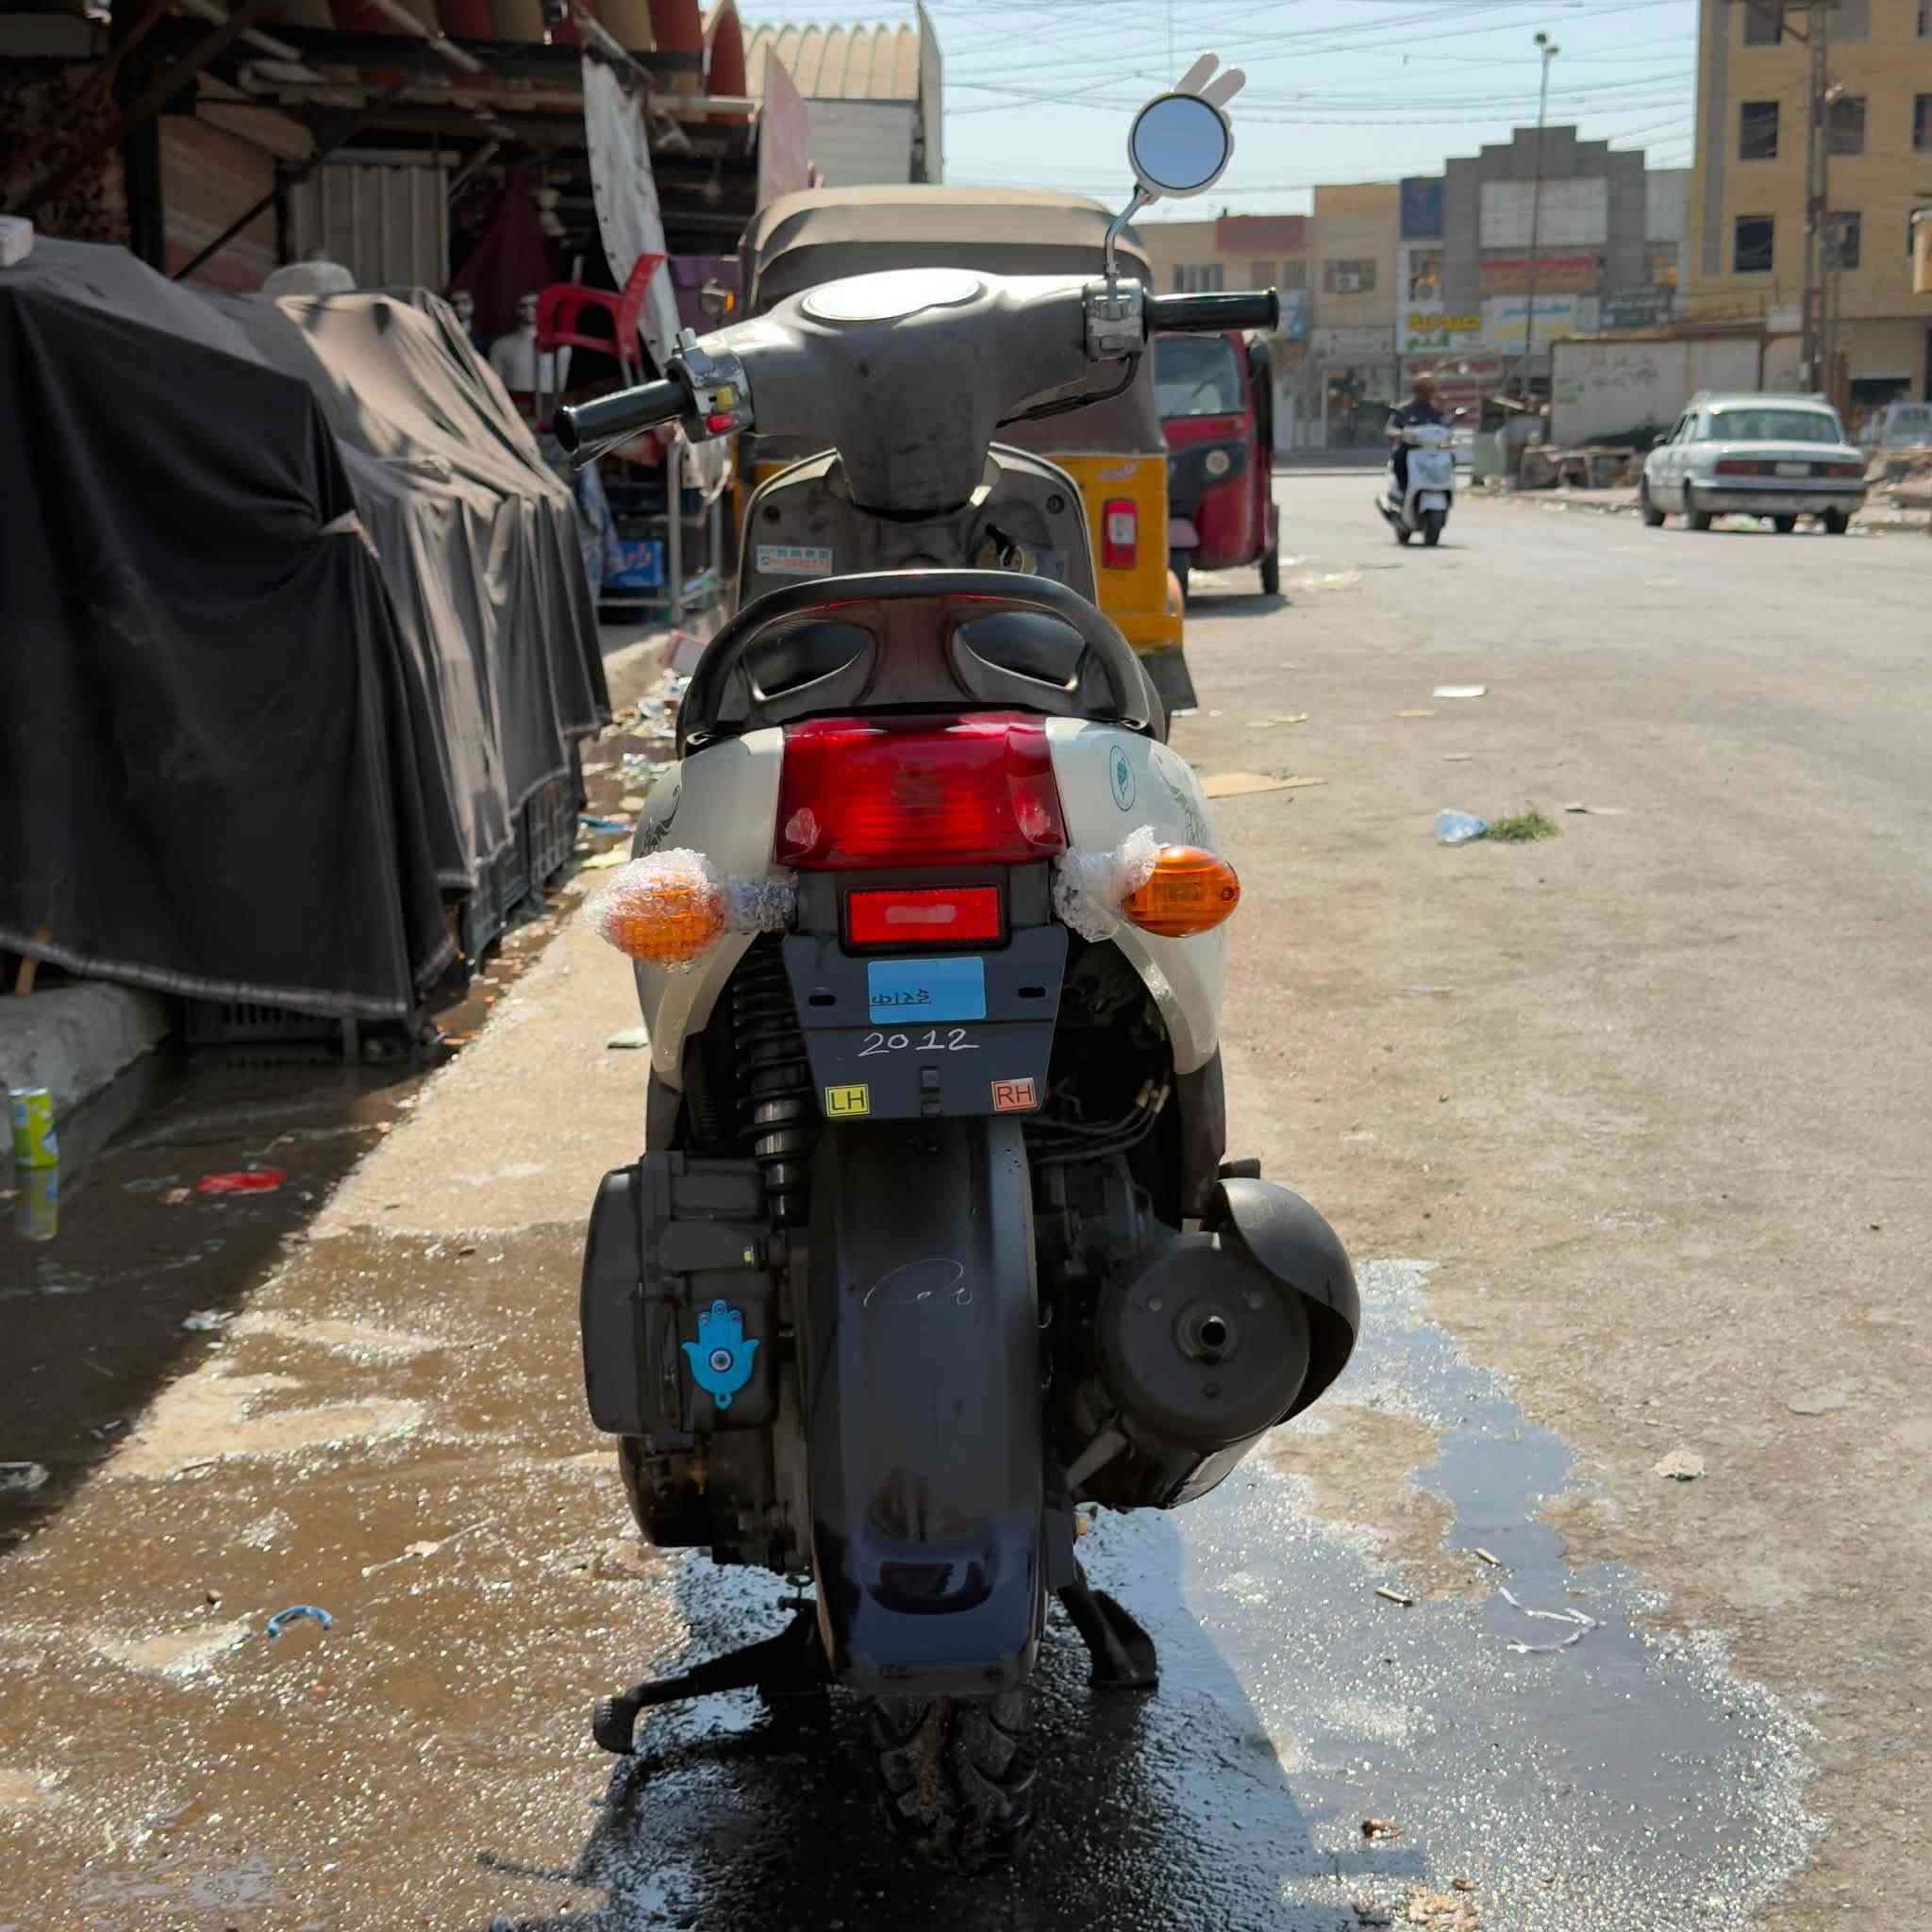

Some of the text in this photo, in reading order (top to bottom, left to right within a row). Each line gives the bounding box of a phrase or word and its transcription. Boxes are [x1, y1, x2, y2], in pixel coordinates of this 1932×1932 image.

[858, 1027, 980, 1058] 2012
[831, 1090, 865, 1111] LH
[996, 1084, 1033, 1106] RH
